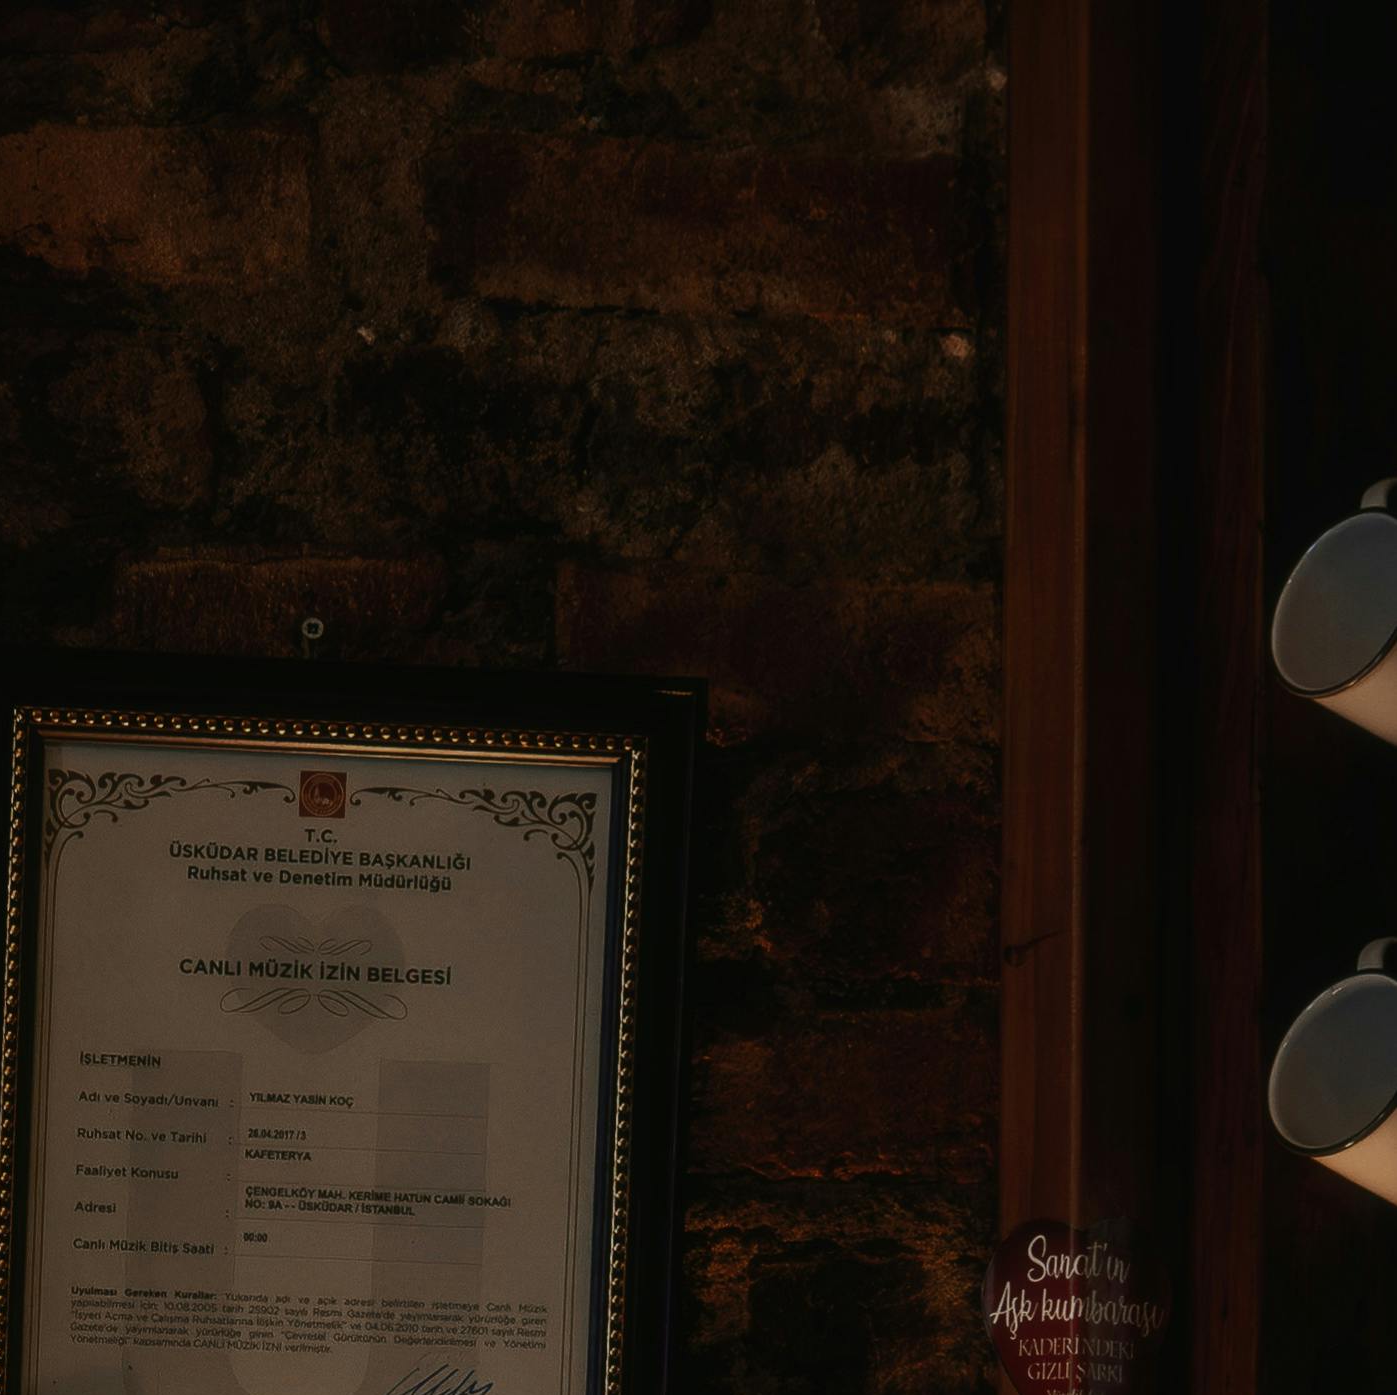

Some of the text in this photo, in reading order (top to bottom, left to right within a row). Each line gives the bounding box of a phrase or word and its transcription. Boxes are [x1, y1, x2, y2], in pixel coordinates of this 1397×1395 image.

[305, 829, 338, 843] T.C.
[169, 840, 471, 872] ÜSKÜDAR BELEDİYE BAŞKANLIĞI
[187, 865, 452, 893] Ruhsat ve Denetim Müdürlüğü
[179, 958, 452, 986] CANLI MÜZİK İZİN BELGESİ
[80, 1051, 162, 1068] İŞLETMENİN
[78, 1090, 101, 1103] Adı
[105, 1093, 120, 1103] ve
[249, 1092, 291, 1105] YILMAZ
[329, 1095, 355, 1108] KOÇ
[77, 1128, 121, 1141] Ruhsat
[152, 1133, 167, 1143] ve
[170, 1131, 208, 1144] Tarihi
[245, 1149, 312, 1162] KAFETERYA
[75, 1164, 179, 1180] Faaliyet Konusu
[245, 1186, 315, 1199] ÇENGELKÖY
[74, 1201, 116, 1214] Adresi
[73, 1238, 105, 1250] Canlı
[109, 1239, 147, 1252] Müzik
[182, 1243, 214, 1255] Saati
[990, 1281, 1038, 1340] Aşk
